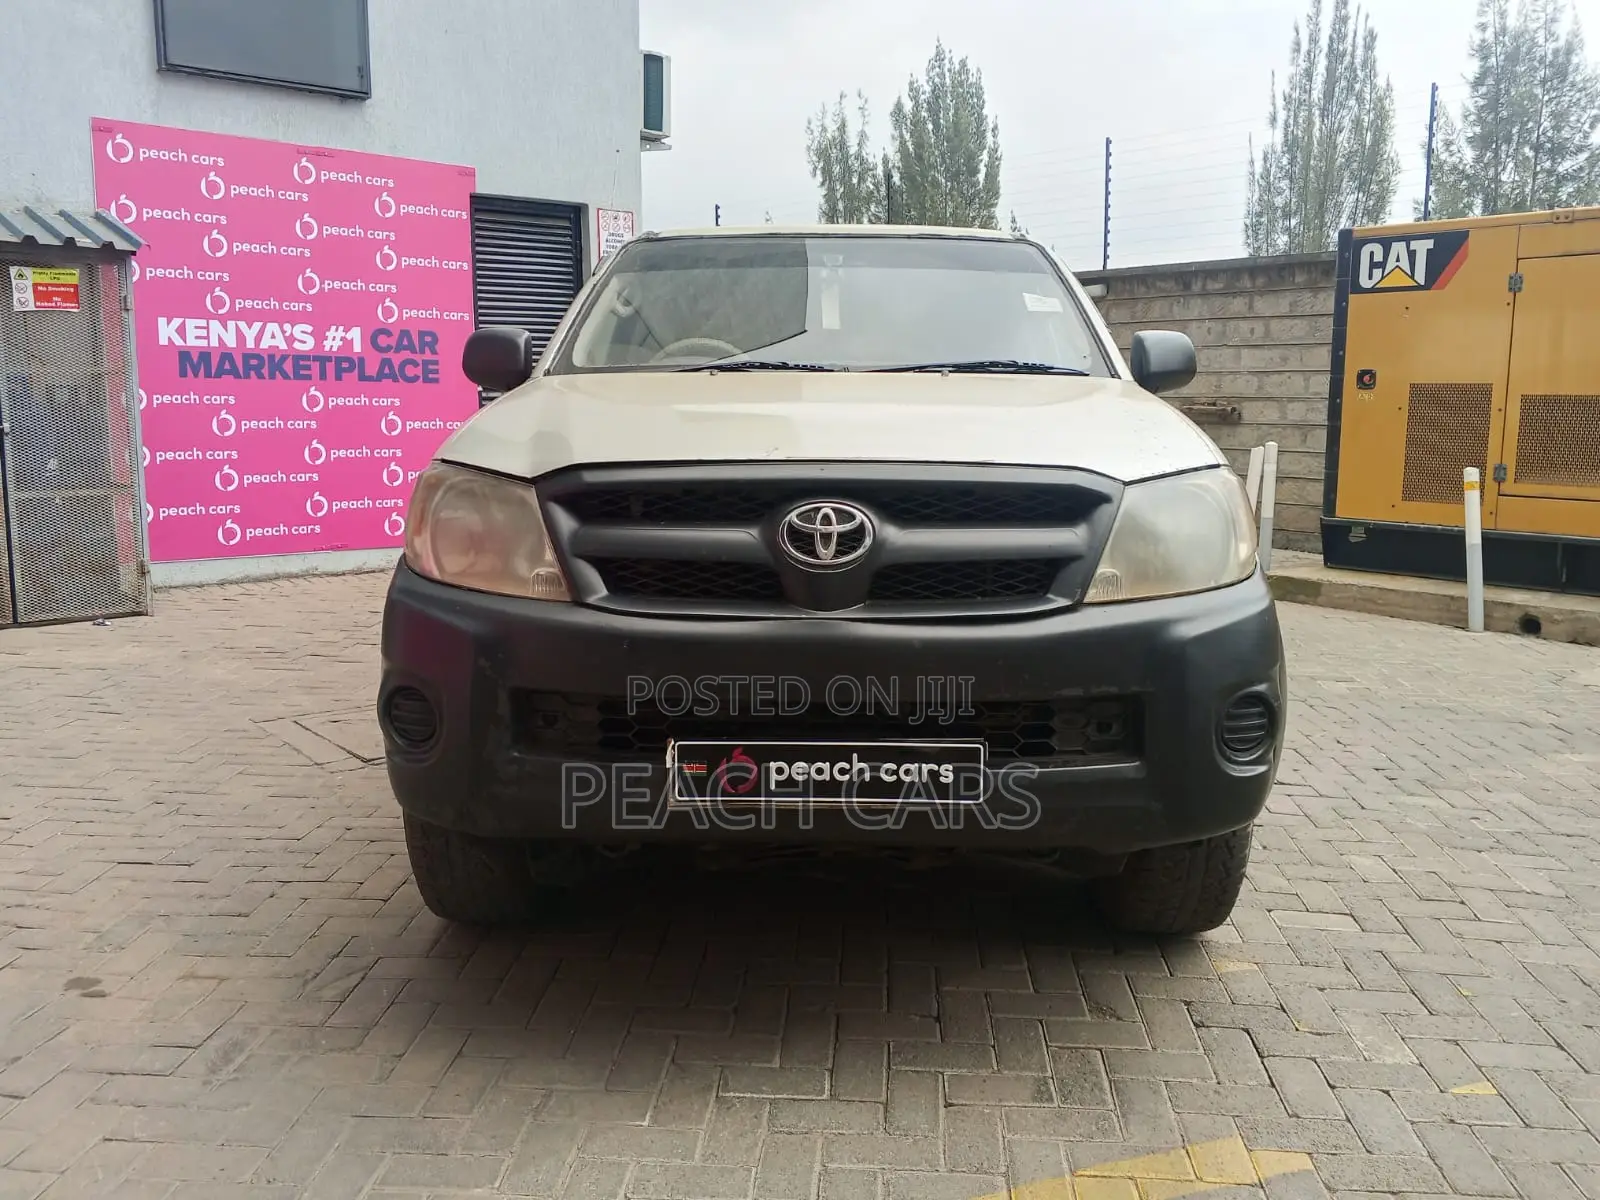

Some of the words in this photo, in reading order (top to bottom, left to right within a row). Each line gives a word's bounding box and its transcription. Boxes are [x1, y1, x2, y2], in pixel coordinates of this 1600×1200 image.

[139, 148, 188, 163] peach
[192, 155, 225, 167] cars
[320, 167, 363, 185] peach
[366, 172, 395, 187] cars
[230, 184, 275, 199] peach
[278, 190, 309, 202] cars
[143, 207, 188, 222] peach
[194, 212, 228, 225] cars
[400, 204, 440, 216] peach
[441, 209, 468, 220] cars
[323, 225, 364, 239] peach
[367, 229, 396, 241] cars
[233, 241, 277, 255] peach
[280, 246, 312, 258] cars
[401, 256, 439, 269] peach
[442, 260, 468, 270] cars
[1358, 239, 1434, 289] CAT
[146, 266, 193, 280] peach
[197, 271, 229, 281] cars
[324, 279, 364, 293] peach
[368, 284, 398, 294] cars
[235, 297, 279, 312] peach
[283, 301, 313, 312] cars
[403, 305, 440, 320] peach
[443, 312, 469, 320] cars
[157, 317, 315, 350] KENYA'S
[323, 325, 363, 352] #1
[370, 328, 440, 355] CAR
[178, 350, 440, 384] MARKETPLACE
[153, 391, 199, 407] peach
[203, 396, 235, 404] cars
[329, 394, 369, 409] peach
[372, 398, 400, 406] cars
[241, 417, 284, 432] peach
[287, 421, 317, 429] cars
[406, 418, 443, 432] peach
[446, 421, 464, 430] ca
[156, 448, 202, 464] peach
[206, 451, 238, 460] cars
[331, 446, 370, 461] peach
[374, 449, 402, 458] cars
[244, 471, 286, 487] peach
[290, 473, 318, 481] cars
[160, 503, 205, 520] peach
[209, 505, 240, 515] cars
[333, 497, 372, 513] peach
[376, 499, 403, 508] cars
[246, 524, 288, 540] peach
[292, 525, 320, 534] cars
[769, 753, 870, 790] peach
[879, 759, 954, 784] cars
